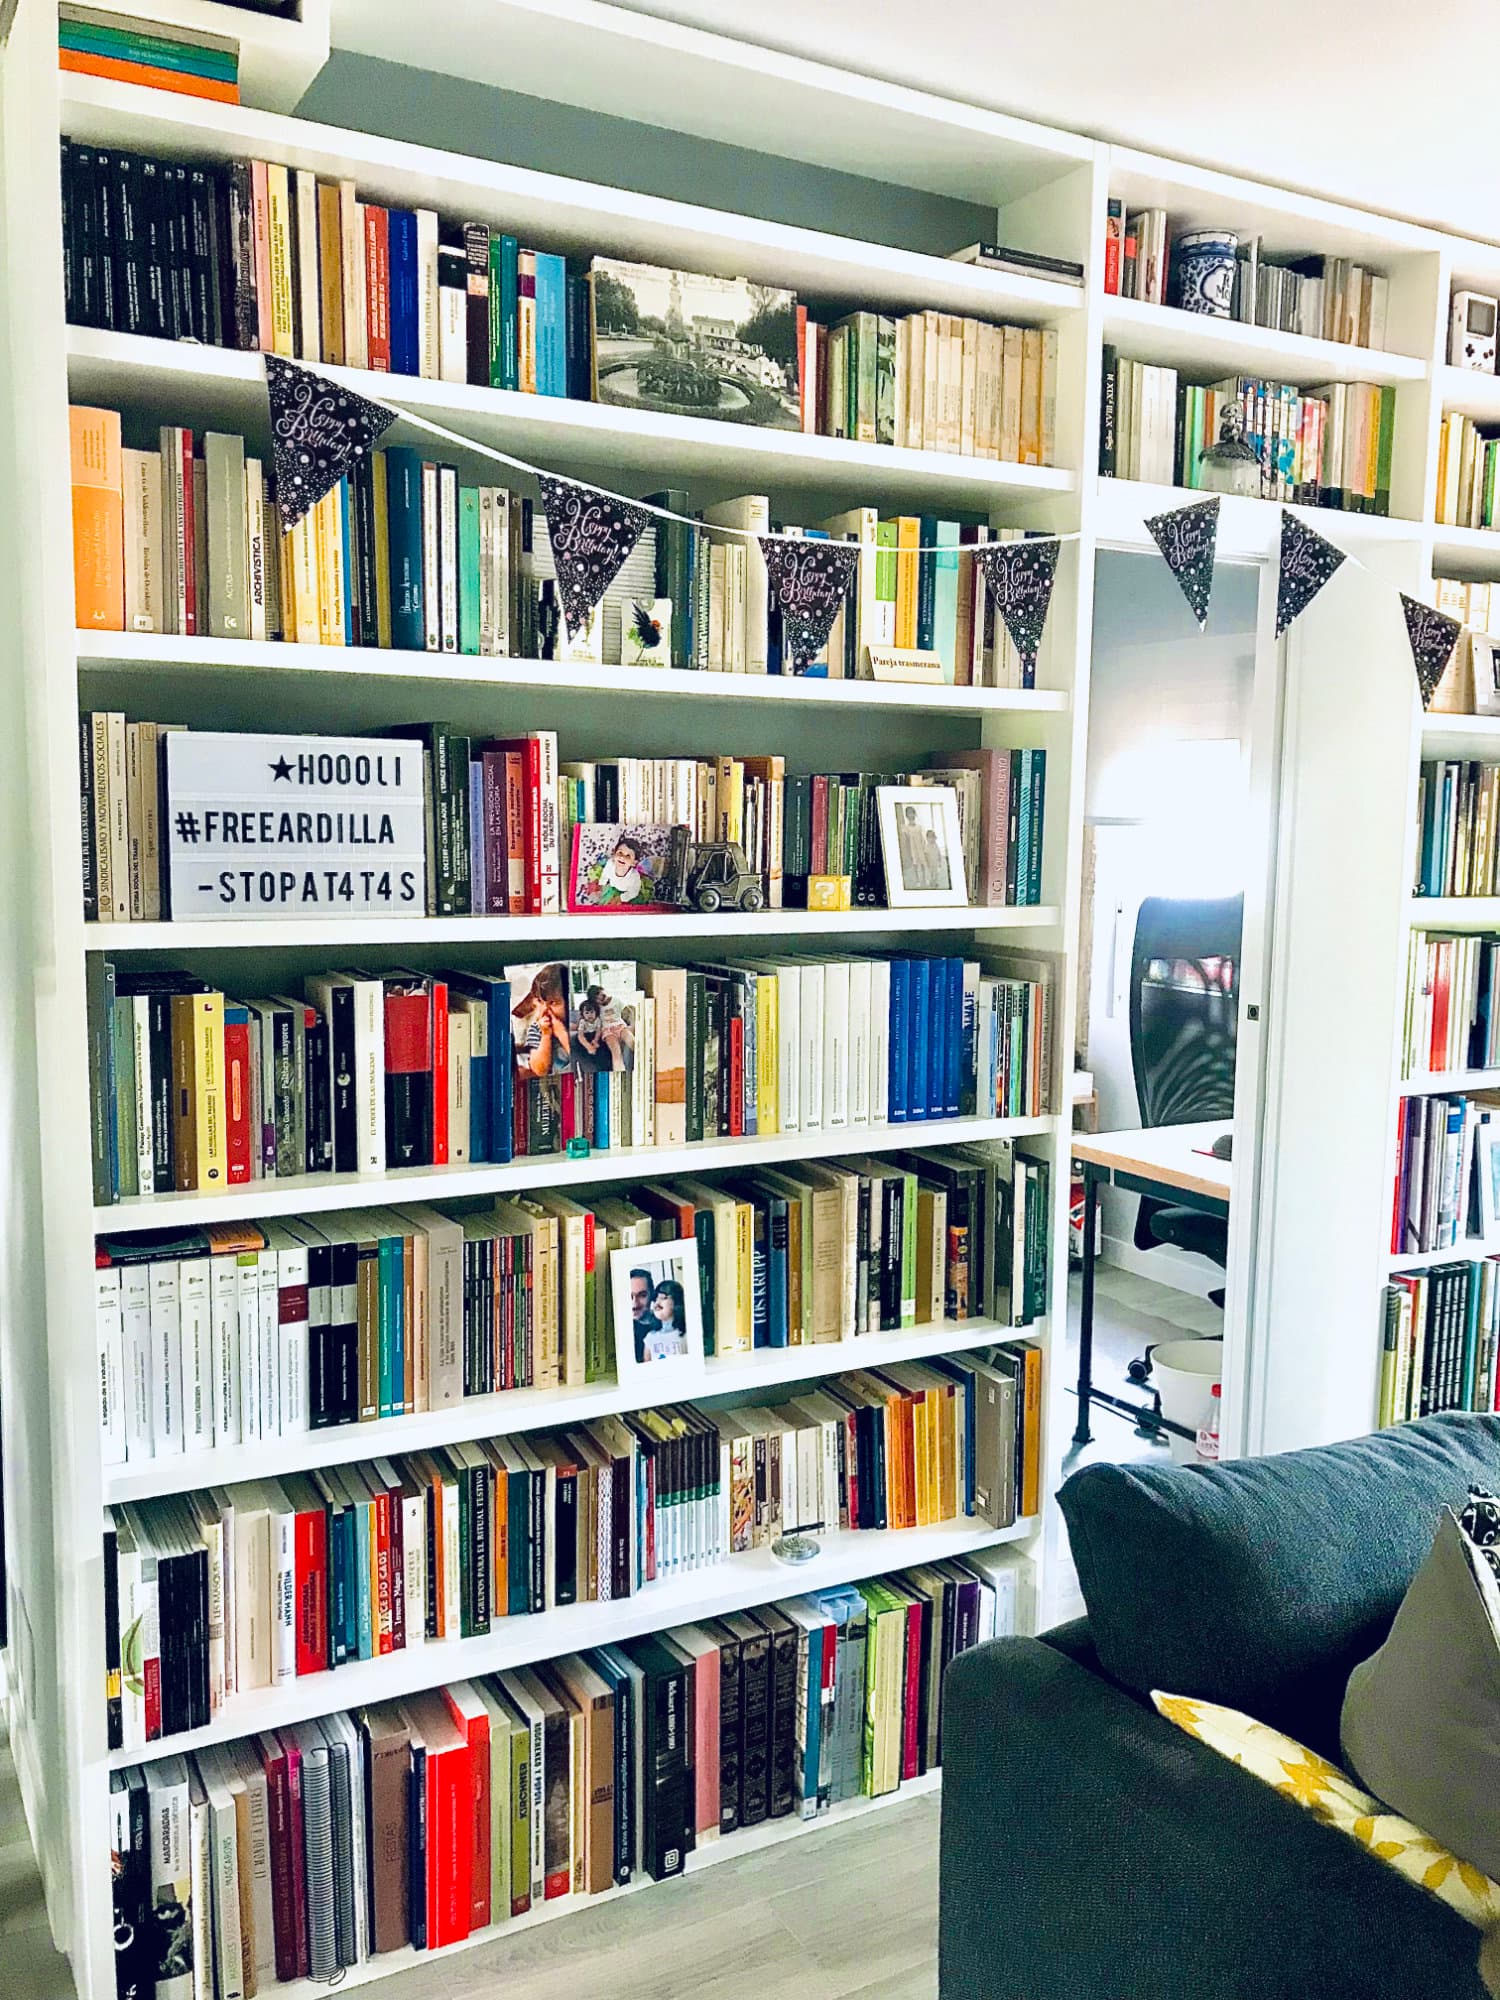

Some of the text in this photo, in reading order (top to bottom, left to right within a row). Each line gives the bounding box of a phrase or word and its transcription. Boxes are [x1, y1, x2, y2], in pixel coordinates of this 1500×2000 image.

[1106, 383, 1114, 399] XIX
[294, 384, 352, 441] Happy
[566, 498, 617, 543] Happy
[785, 552, 833, 588] Happy
[996, 557, 1040, 588] Happy
[872, 656, 941, 670] Pareja trasmerana
[96, 720, 105, 761] SOCIALES
[298, 754, 402, 787] HOOOLI
[98, 763, 107, 823] MOVIMIENTOS
[174, 811, 395, 844] #FREEARDILLA
[496, 815, 501, 825] LA
[994, 757, 1007, 872] SOLIDARIDAD DESDE ABAJO
[489, 826, 495, 836] LA
[496, 826, 502, 836] EN
[550, 838, 555, 847] DU
[82, 844, 89, 854] DE
[100, 832, 109, 892] SINDICALISMO
[543, 843, 549, 852] LE
[281, 1023, 291, 1089] Palabras mayores
[282, 1095, 290, 1123] Gancedo
[541, 1093, 550, 1136] MUJERES
[476, 1508, 484, 1540] RITUAL
[476, 1542, 484, 1552] EL
[378, 1551, 388, 1579] CAOS
[476, 1555, 485, 1577] PARA
[284, 1570, 292, 1601] WILDER
[379, 1581, 388, 1598] DO
[477, 1579, 485, 1613] GRUPOS
[519, 1762, 528, 1819] KIRCHNER
[162, 1807, 171, 1864] MASCARADAS
